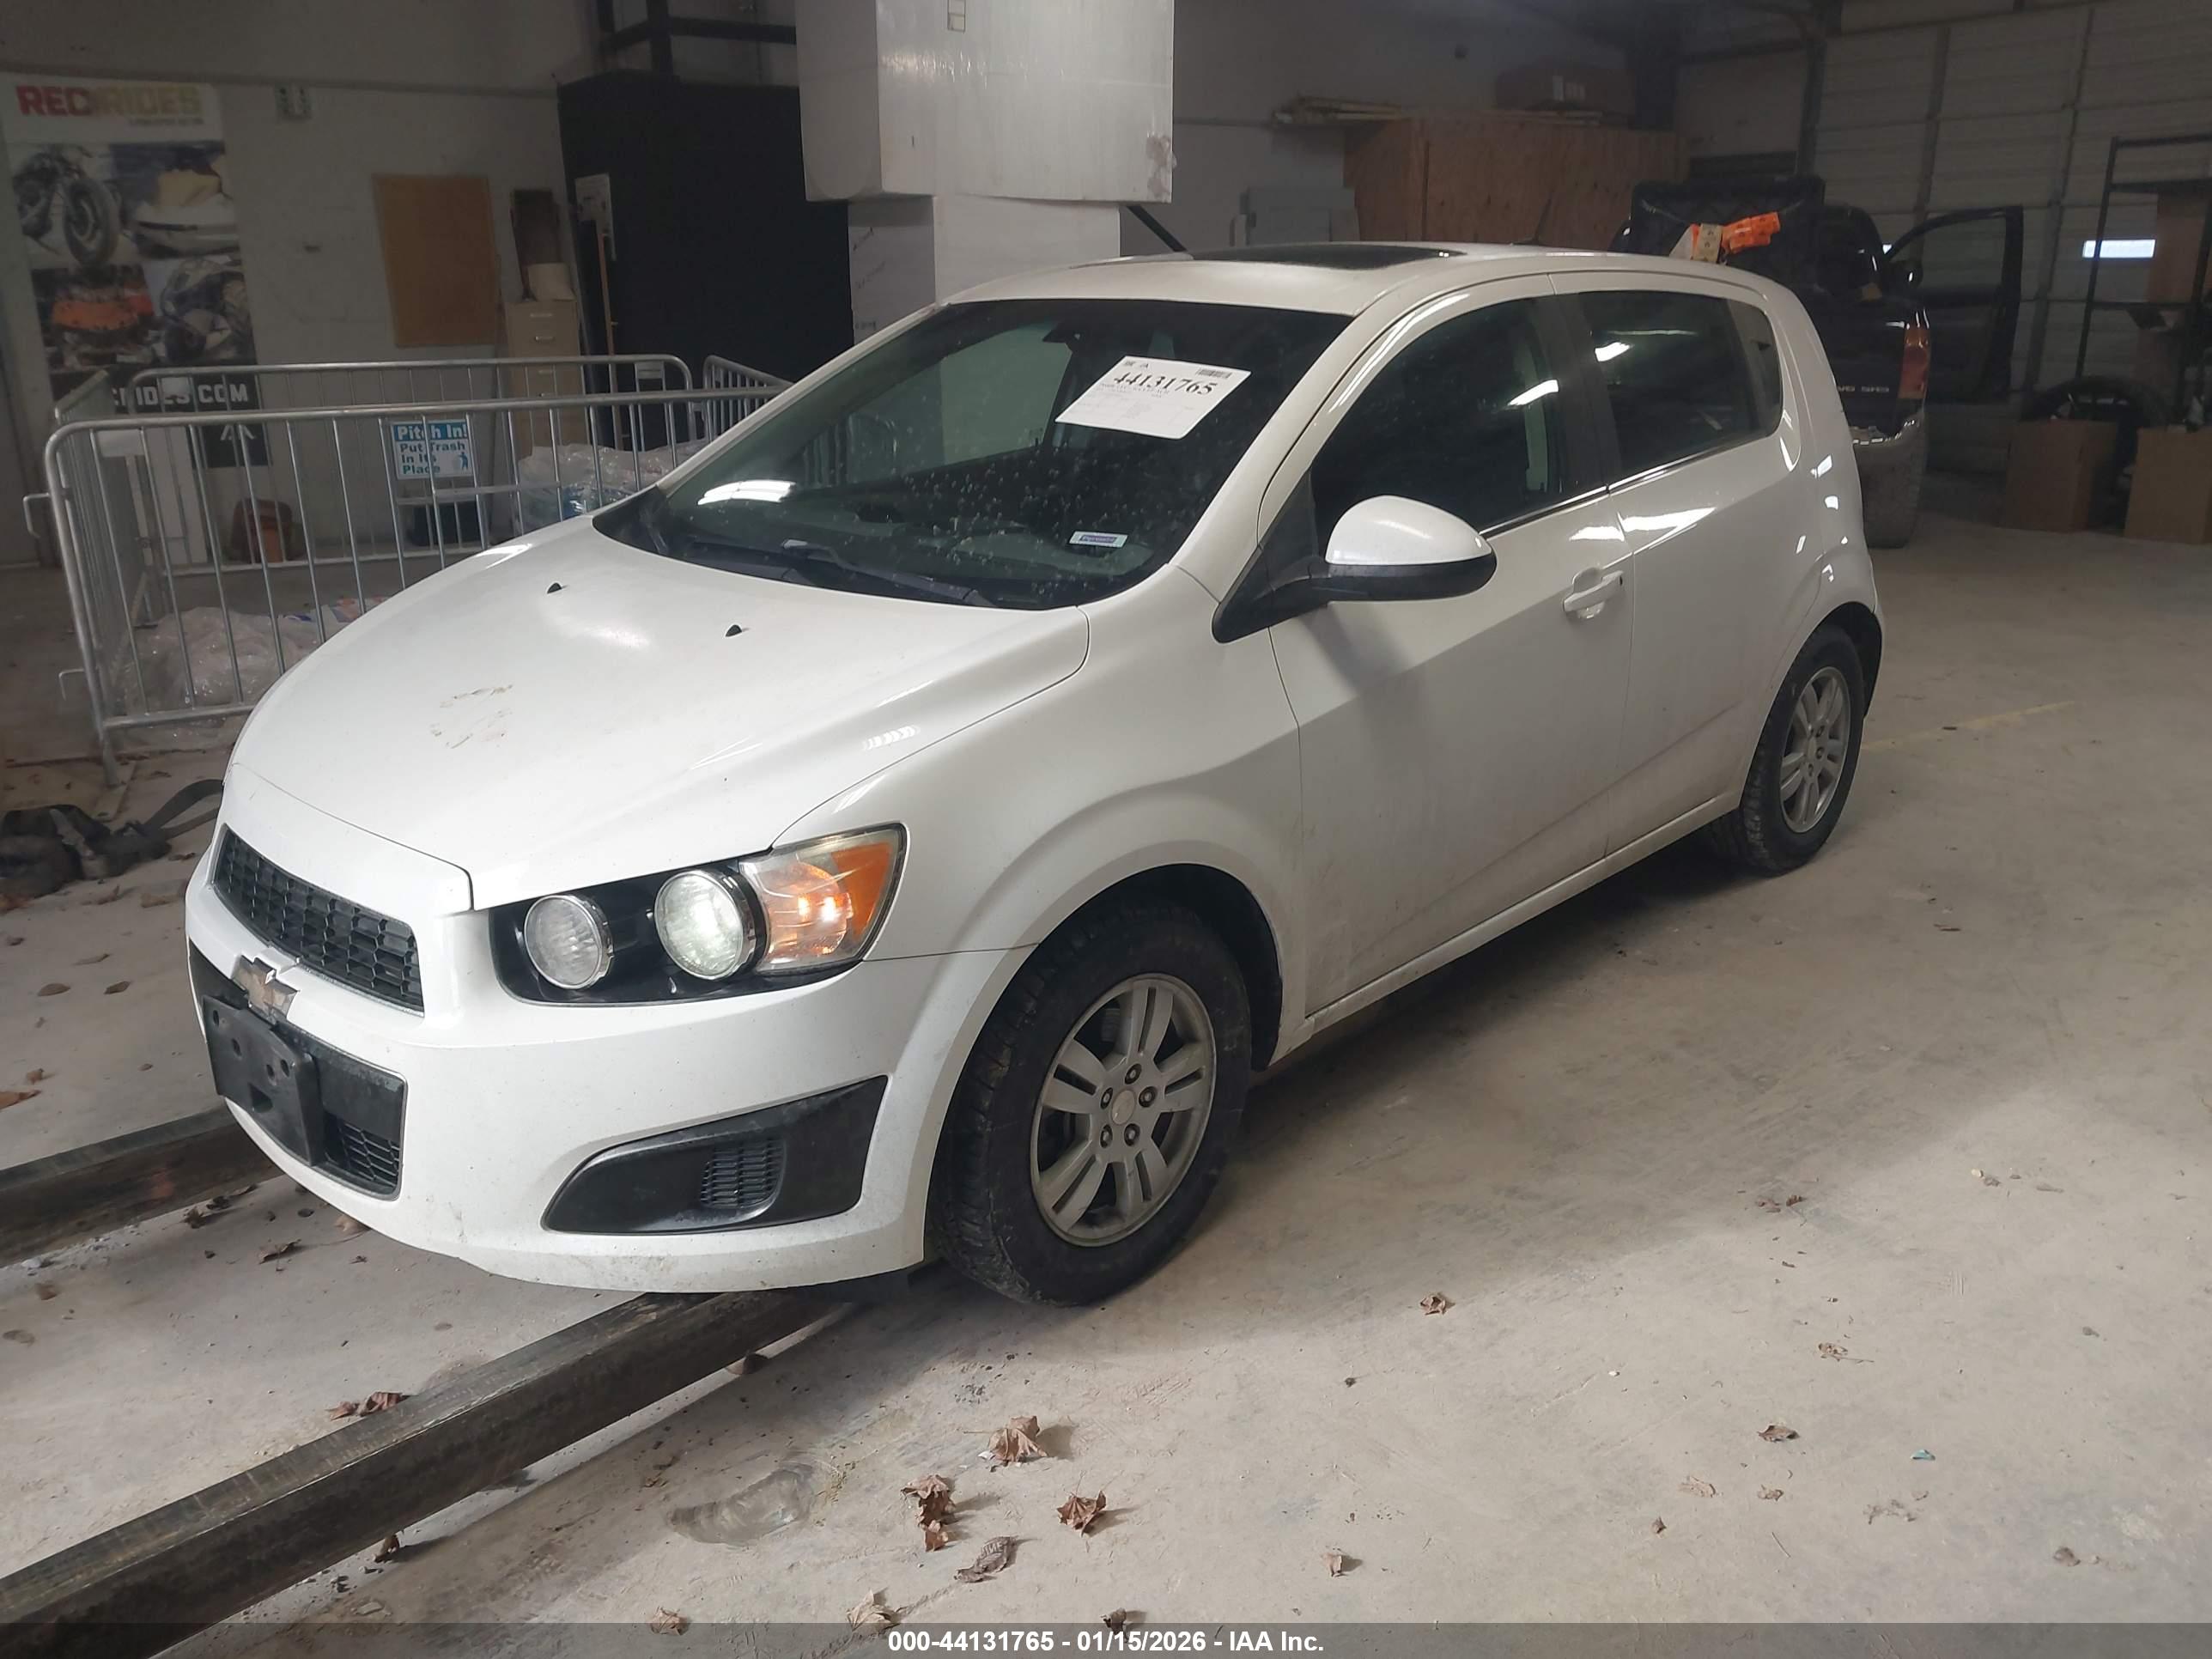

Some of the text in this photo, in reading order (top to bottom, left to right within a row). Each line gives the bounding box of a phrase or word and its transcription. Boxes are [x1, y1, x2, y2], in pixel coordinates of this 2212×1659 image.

[1113, 371, 1218, 395] 44131765
[397, 423, 468, 441] Pith In!
[399, 442, 424, 453] Put
[401, 454, 415, 464] In
